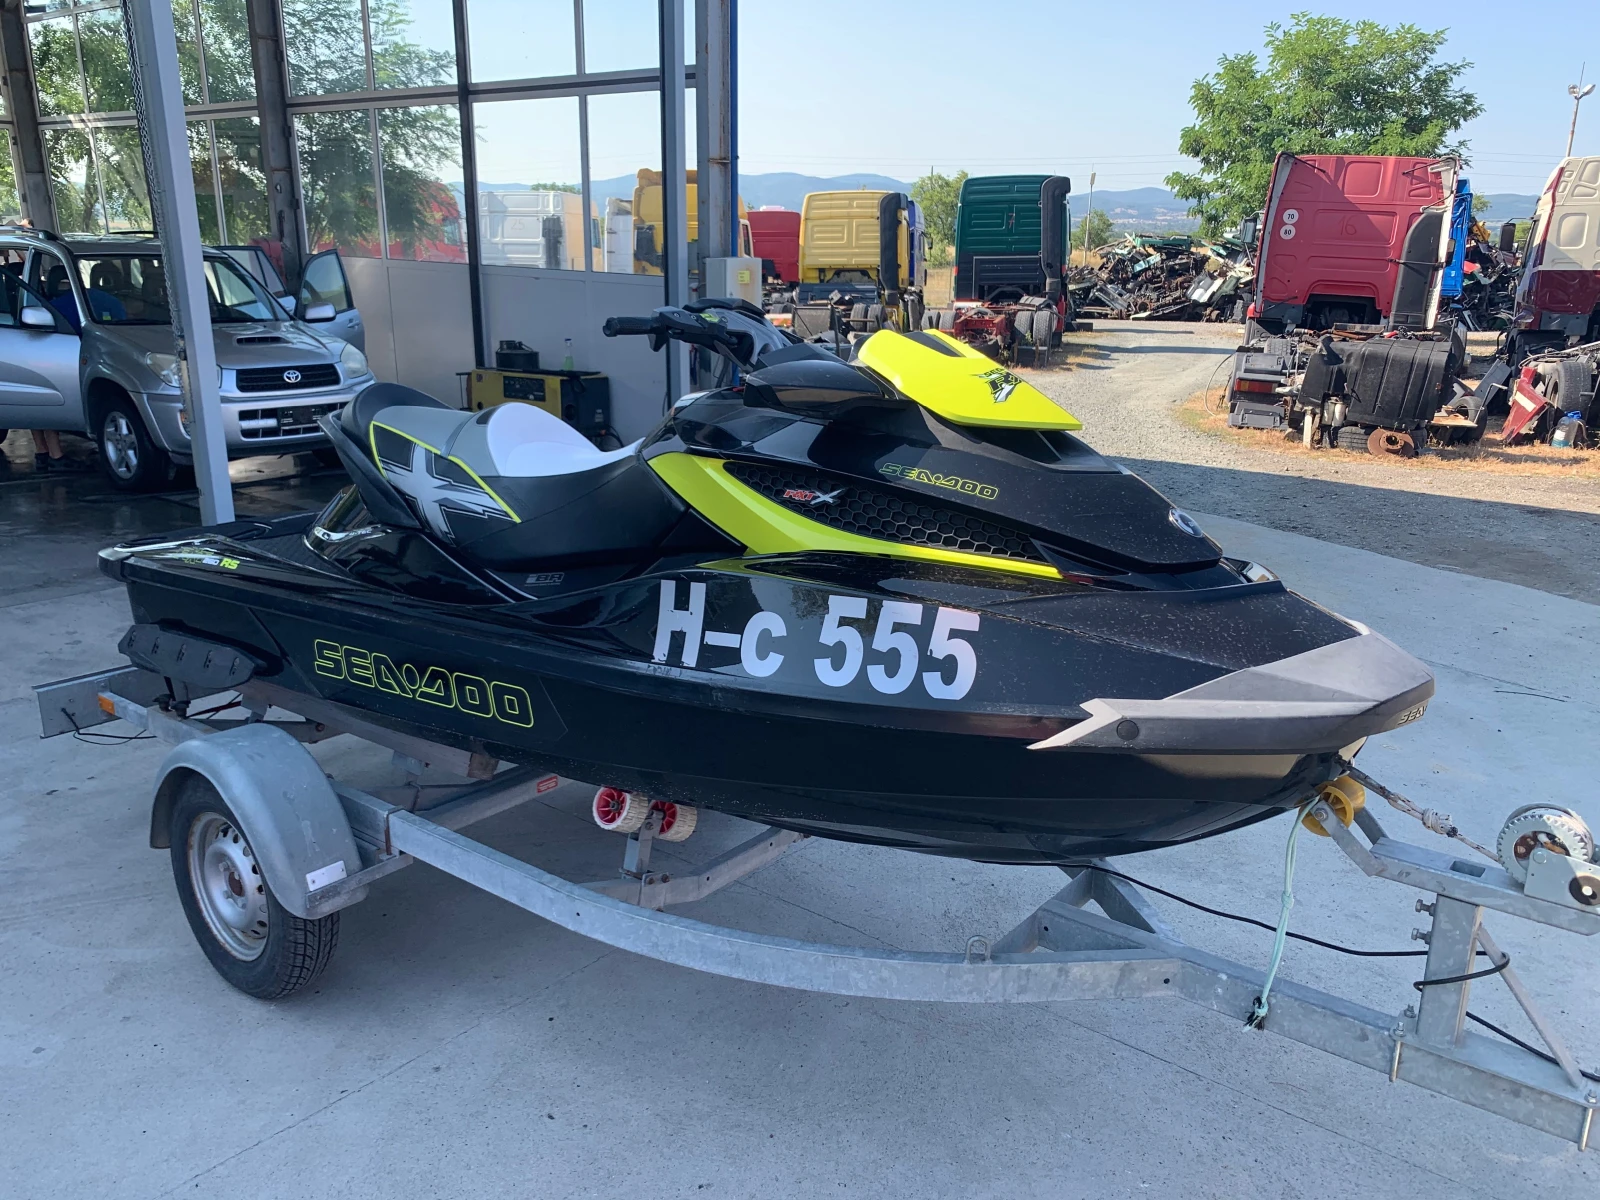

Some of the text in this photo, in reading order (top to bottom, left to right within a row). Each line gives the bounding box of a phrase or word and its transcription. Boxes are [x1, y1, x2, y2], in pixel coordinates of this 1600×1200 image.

[510, 218, 526, 231] 25
[1338, 214, 1358, 236] 16
[220, 557, 240, 570] RS
[813, 594, 981, 701] 555
